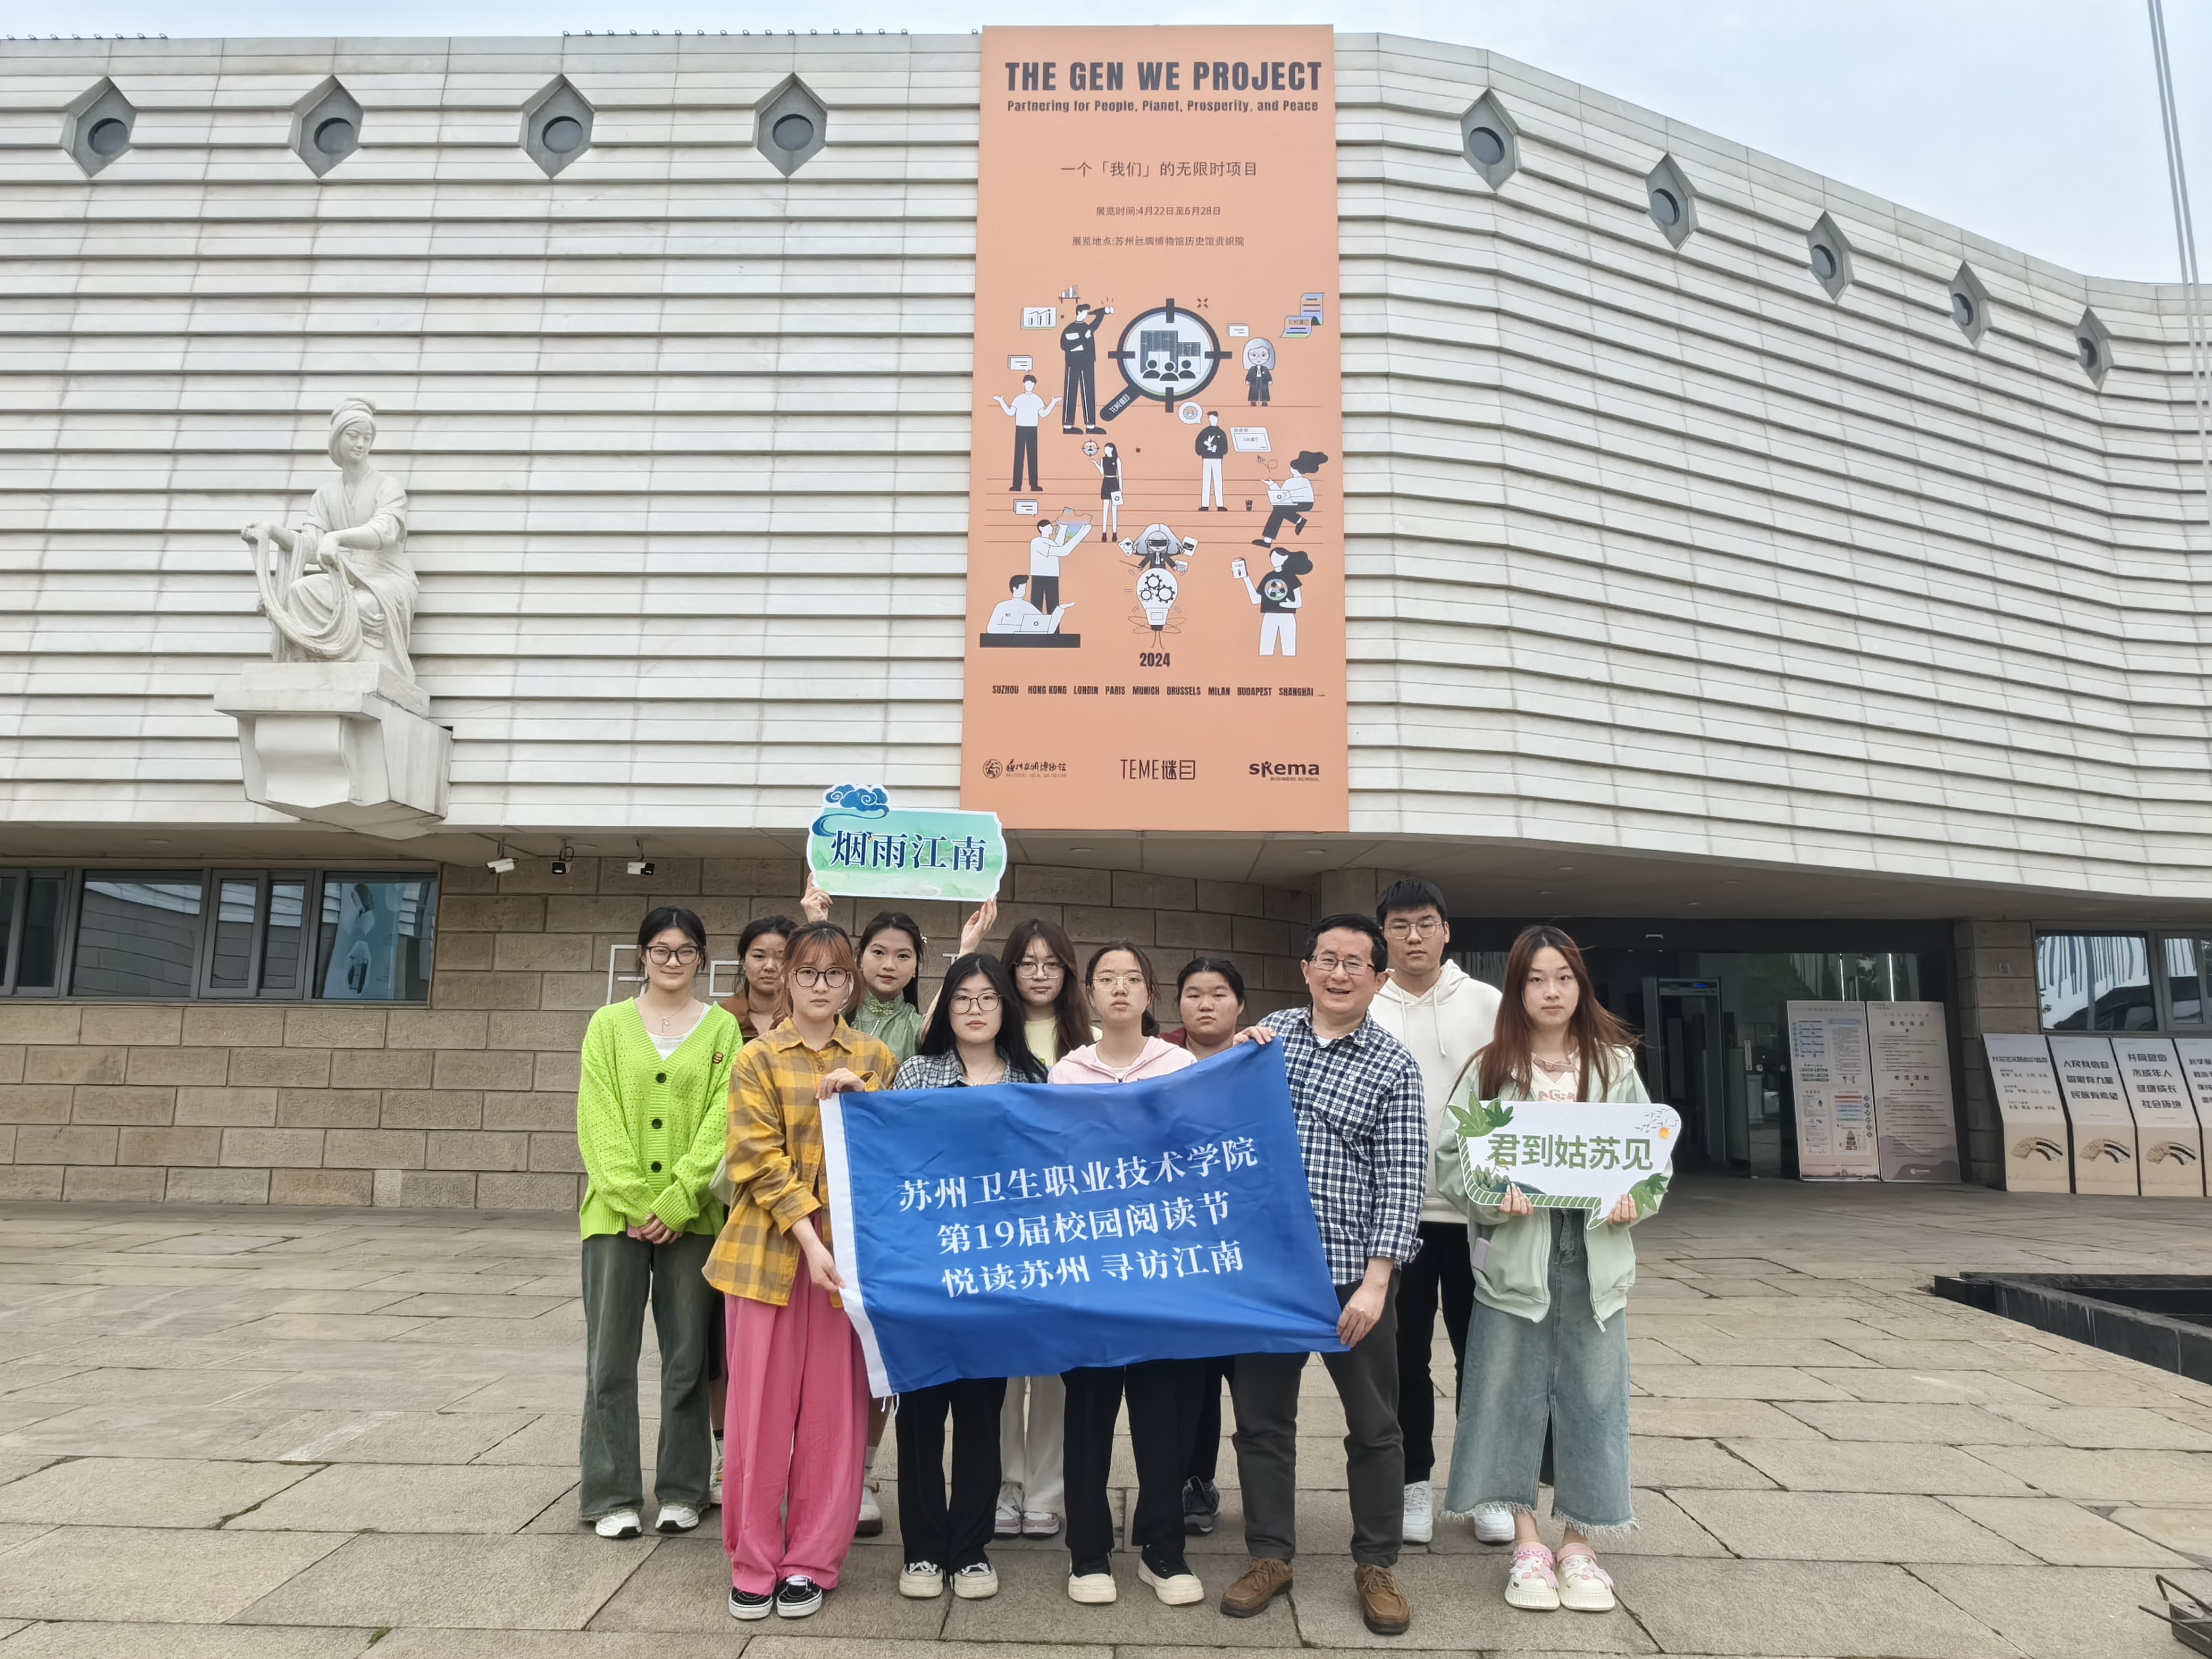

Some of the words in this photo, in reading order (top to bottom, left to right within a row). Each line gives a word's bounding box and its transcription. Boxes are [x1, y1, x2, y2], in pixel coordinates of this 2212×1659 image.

[1005, 62, 1056, 91] THE
[1070, 62, 1123, 91] GEN
[1137, 62, 1179, 91] WE
[1193, 62, 1322, 91] PROJECT
[1007, 99, 1069, 113] Partnering
[1074, 100, 1091, 112] for
[1094, 100, 1138, 113] People,
[1142, 100, 1183, 113] Planet,
[1187, 99, 1253, 113] Prosperity,
[1257, 99, 1279, 112] and
[1283, 100, 1319, 112] Peace
[1060, 161, 1256, 177] 一个「我们」的无限时项目
[1139, 652, 1170, 667] 2024
[992, 685, 1019, 694] SUZHOU
[1028, 685, 1046, 695] HONG
[1049, 685, 1067, 695] KONG
[1105, 686, 1125, 696] PARIS
[1132, 686, 1160, 696] MUNICH
[1167, 686, 1201, 696] BRUSSELS
[1208, 686, 1230, 696] MILAN
[1237, 687, 1272, 697] BUDAPEST
[1279, 688, 1313, 697] SHANGHAI
[1249, 761, 1320, 778] skema
[830, 830, 987, 872] 烟雨江南
[1488, 1133, 1654, 1170] 君到姑苏见
[898, 1136, 1259, 1212] 苏州卫生职业技术学院
[937, 1191, 1230, 1255] 第19届校园阅读节
[941, 1255, 1091, 1299] 悦读苏州
[1100, 1240, 1244, 1281] 寻访江南
